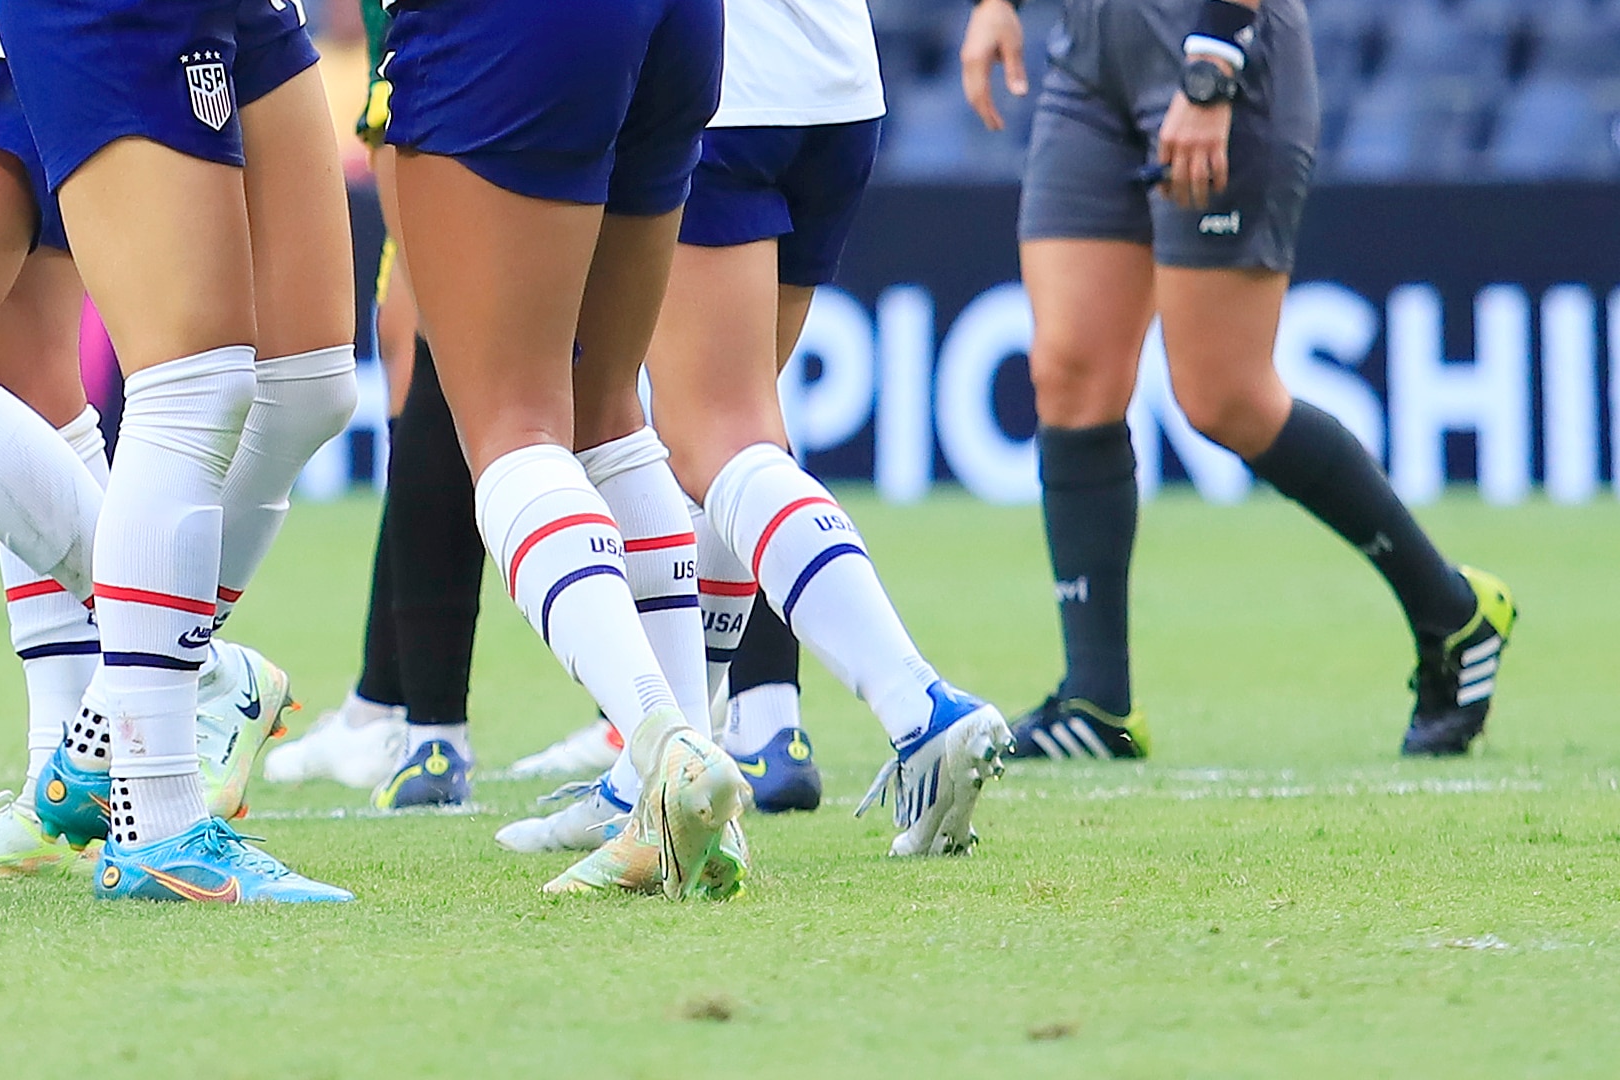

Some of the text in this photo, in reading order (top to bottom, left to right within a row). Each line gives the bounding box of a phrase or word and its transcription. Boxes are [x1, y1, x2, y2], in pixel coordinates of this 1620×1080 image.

[190, 67, 224, 93] USA
[673, 560, 696, 581] US
[702, 609, 744, 634] USA
